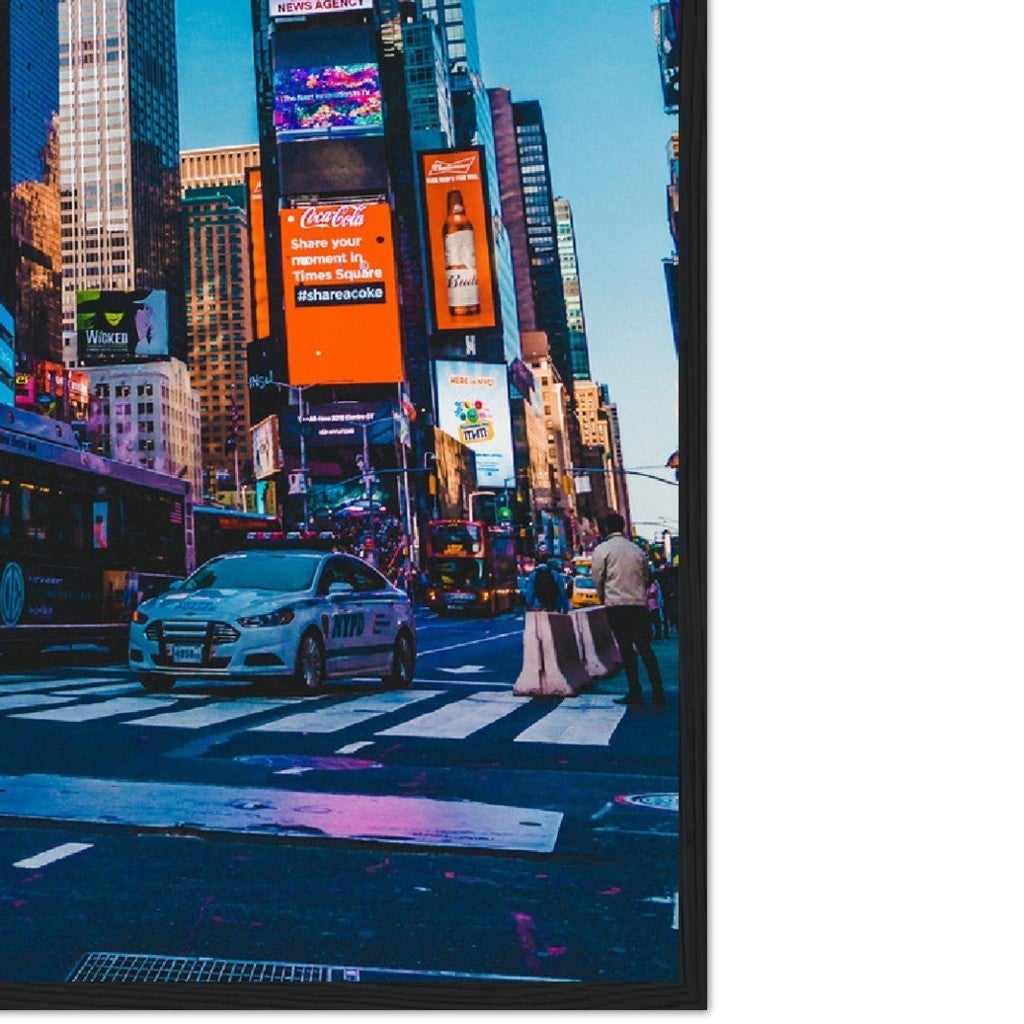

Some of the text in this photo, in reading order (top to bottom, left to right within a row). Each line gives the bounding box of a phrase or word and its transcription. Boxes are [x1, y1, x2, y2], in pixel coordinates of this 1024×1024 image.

[300, 204, 367, 229] Coca-Cola
[291, 237, 362, 250] Share your
[291, 252, 363, 266] moment in
[292, 268, 382, 282] Times Square
[297, 287, 383, 302] #shareacoke
